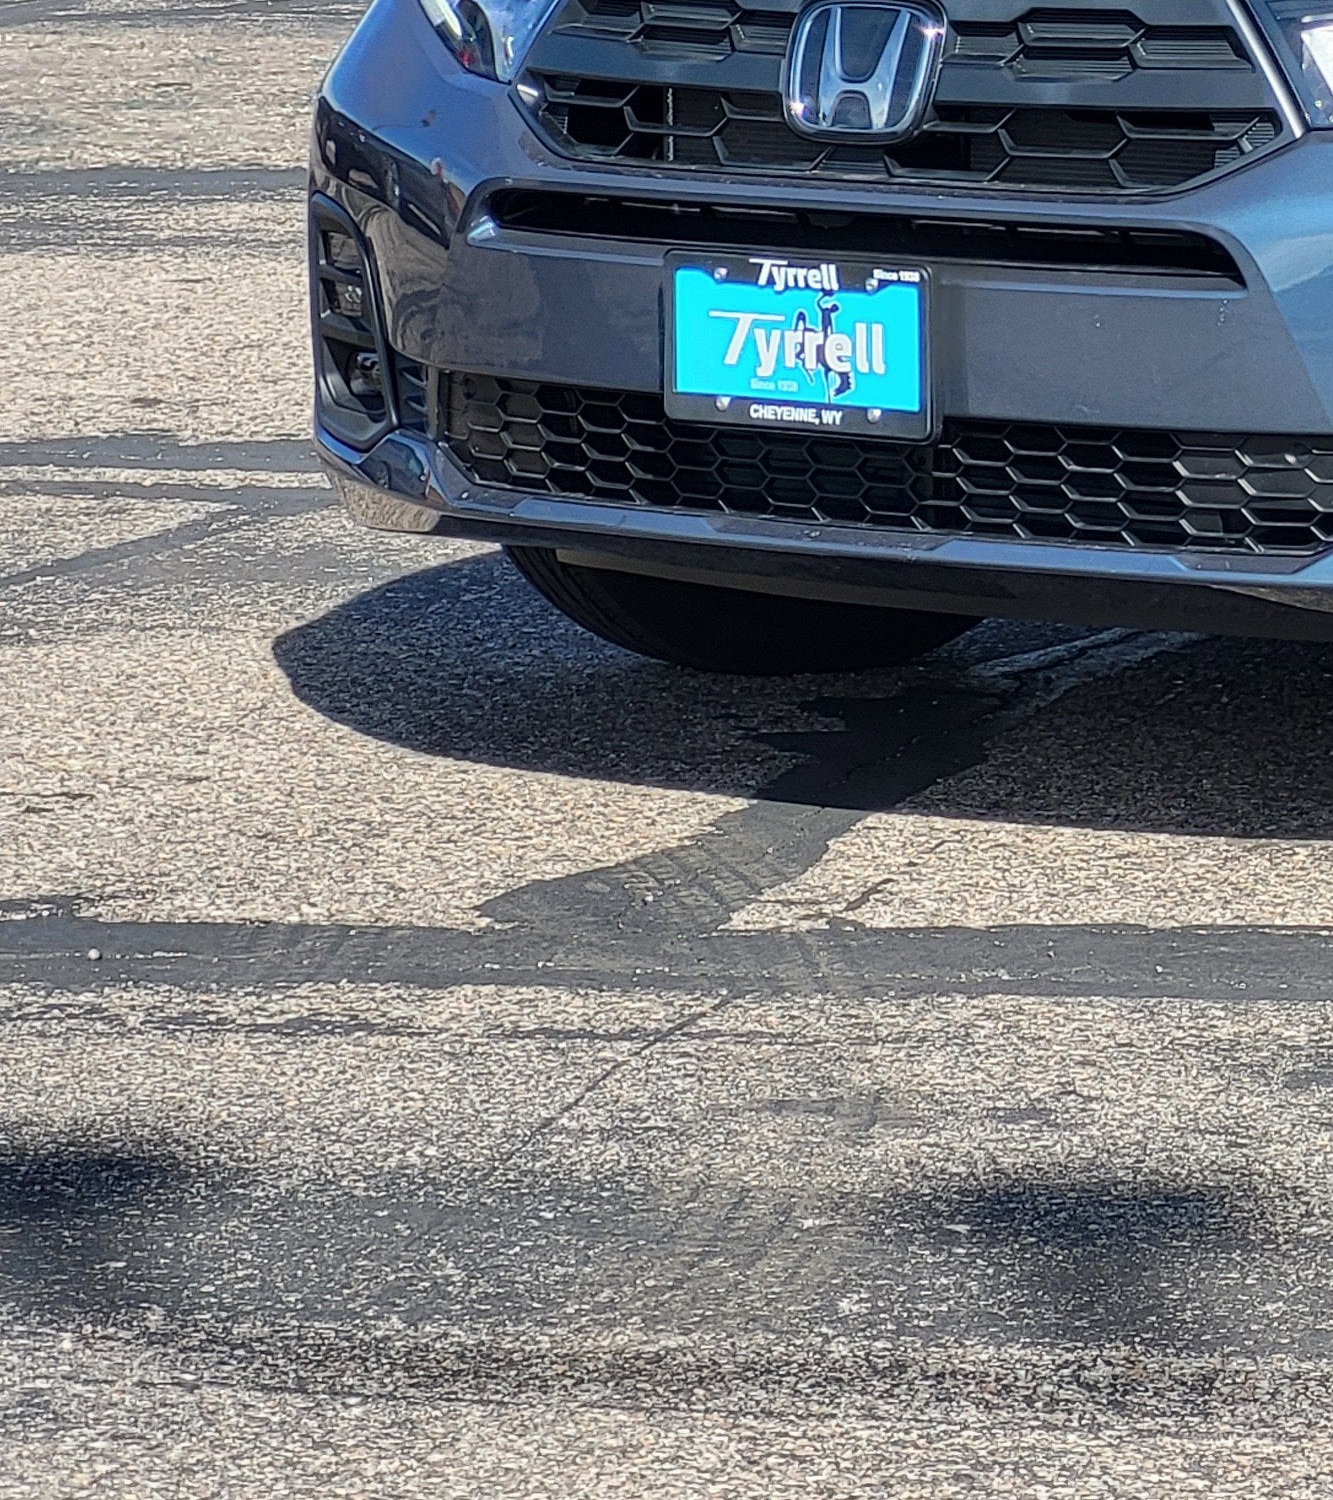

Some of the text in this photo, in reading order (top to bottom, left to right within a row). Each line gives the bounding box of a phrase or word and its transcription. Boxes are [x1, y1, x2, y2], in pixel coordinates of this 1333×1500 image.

[749, 258, 839, 292] Tyrrell
[708, 310, 886, 377] Tyrrell
[749, 403, 843, 425] CHEYENNE, WY
